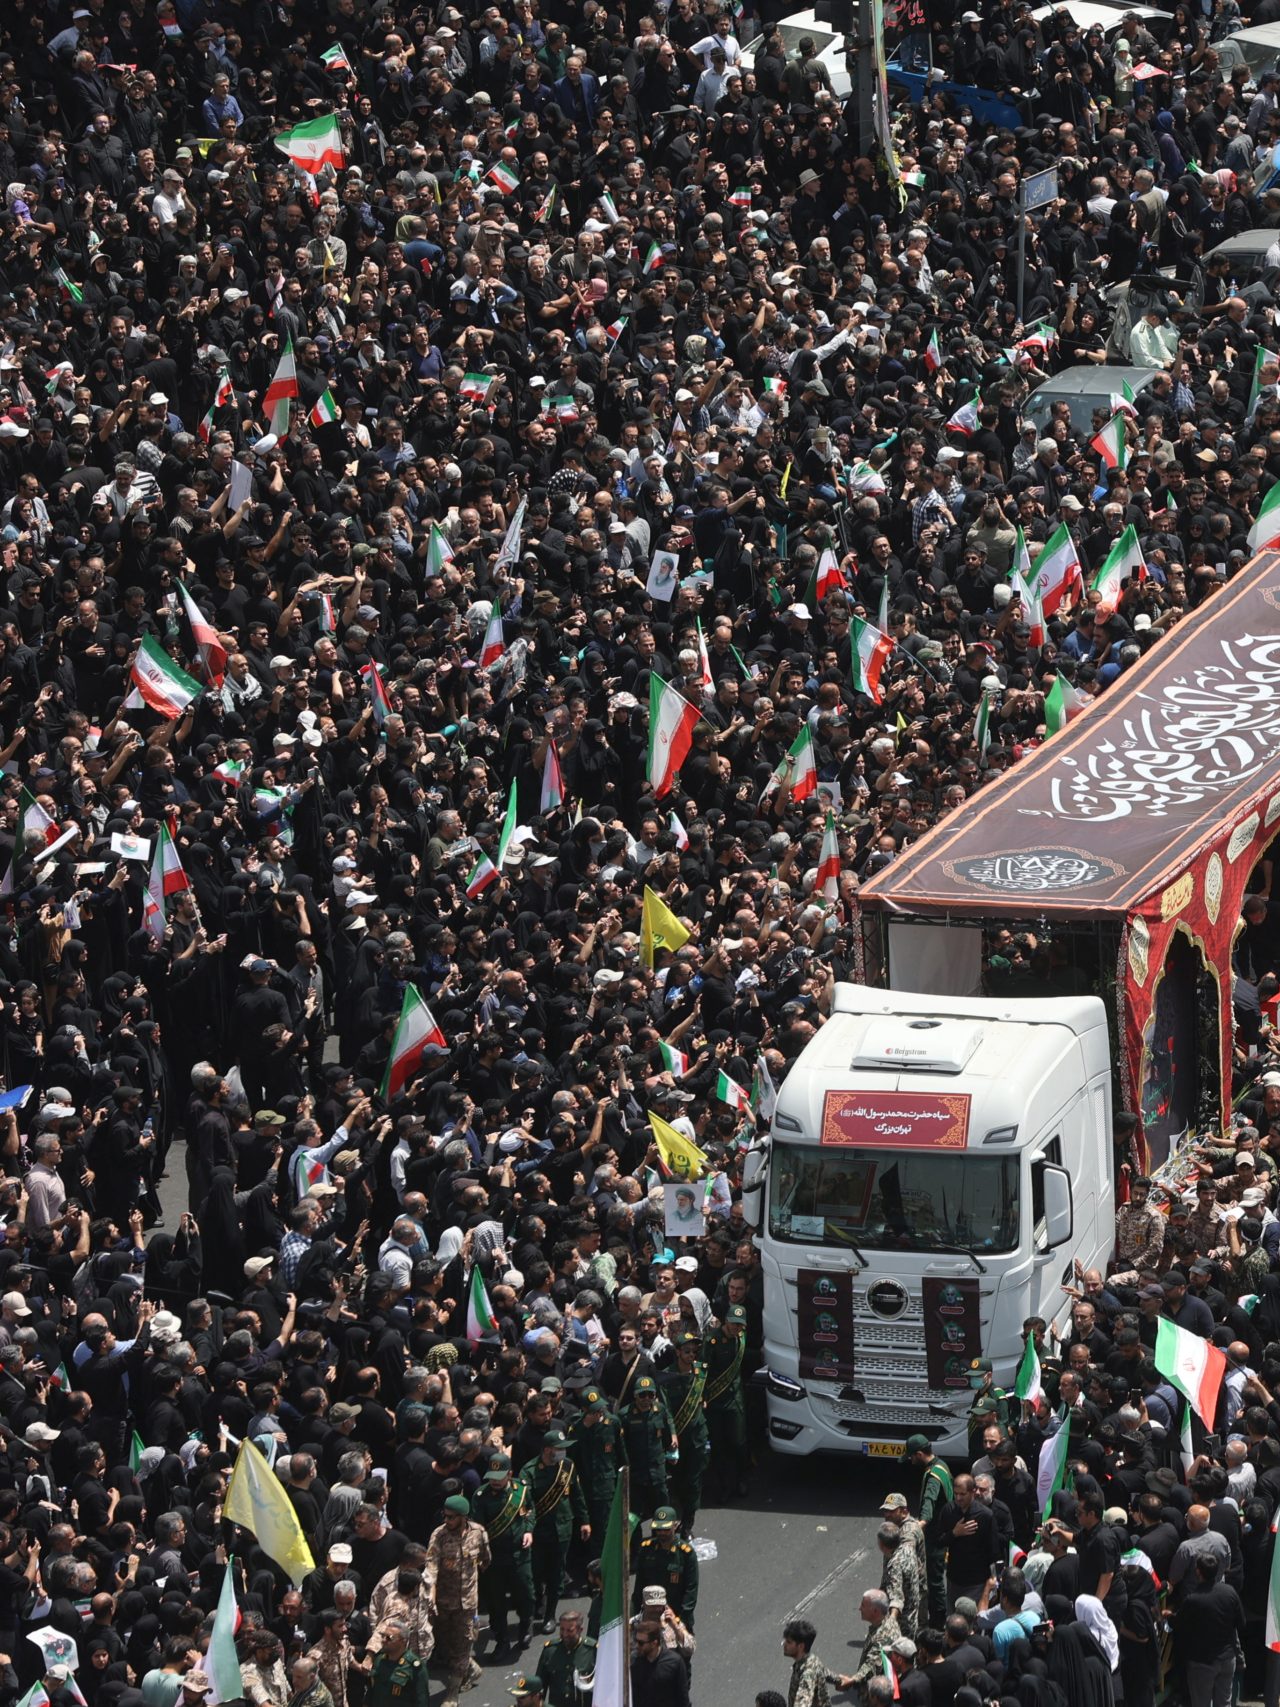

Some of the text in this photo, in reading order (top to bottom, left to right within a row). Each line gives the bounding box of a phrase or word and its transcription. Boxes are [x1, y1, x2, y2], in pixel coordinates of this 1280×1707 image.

[894, 1048, 927, 1056] Bergstrom
[908, 1110, 933, 1120] حضرت
[874, 1123, 912, 1135] تهران بزرگ
